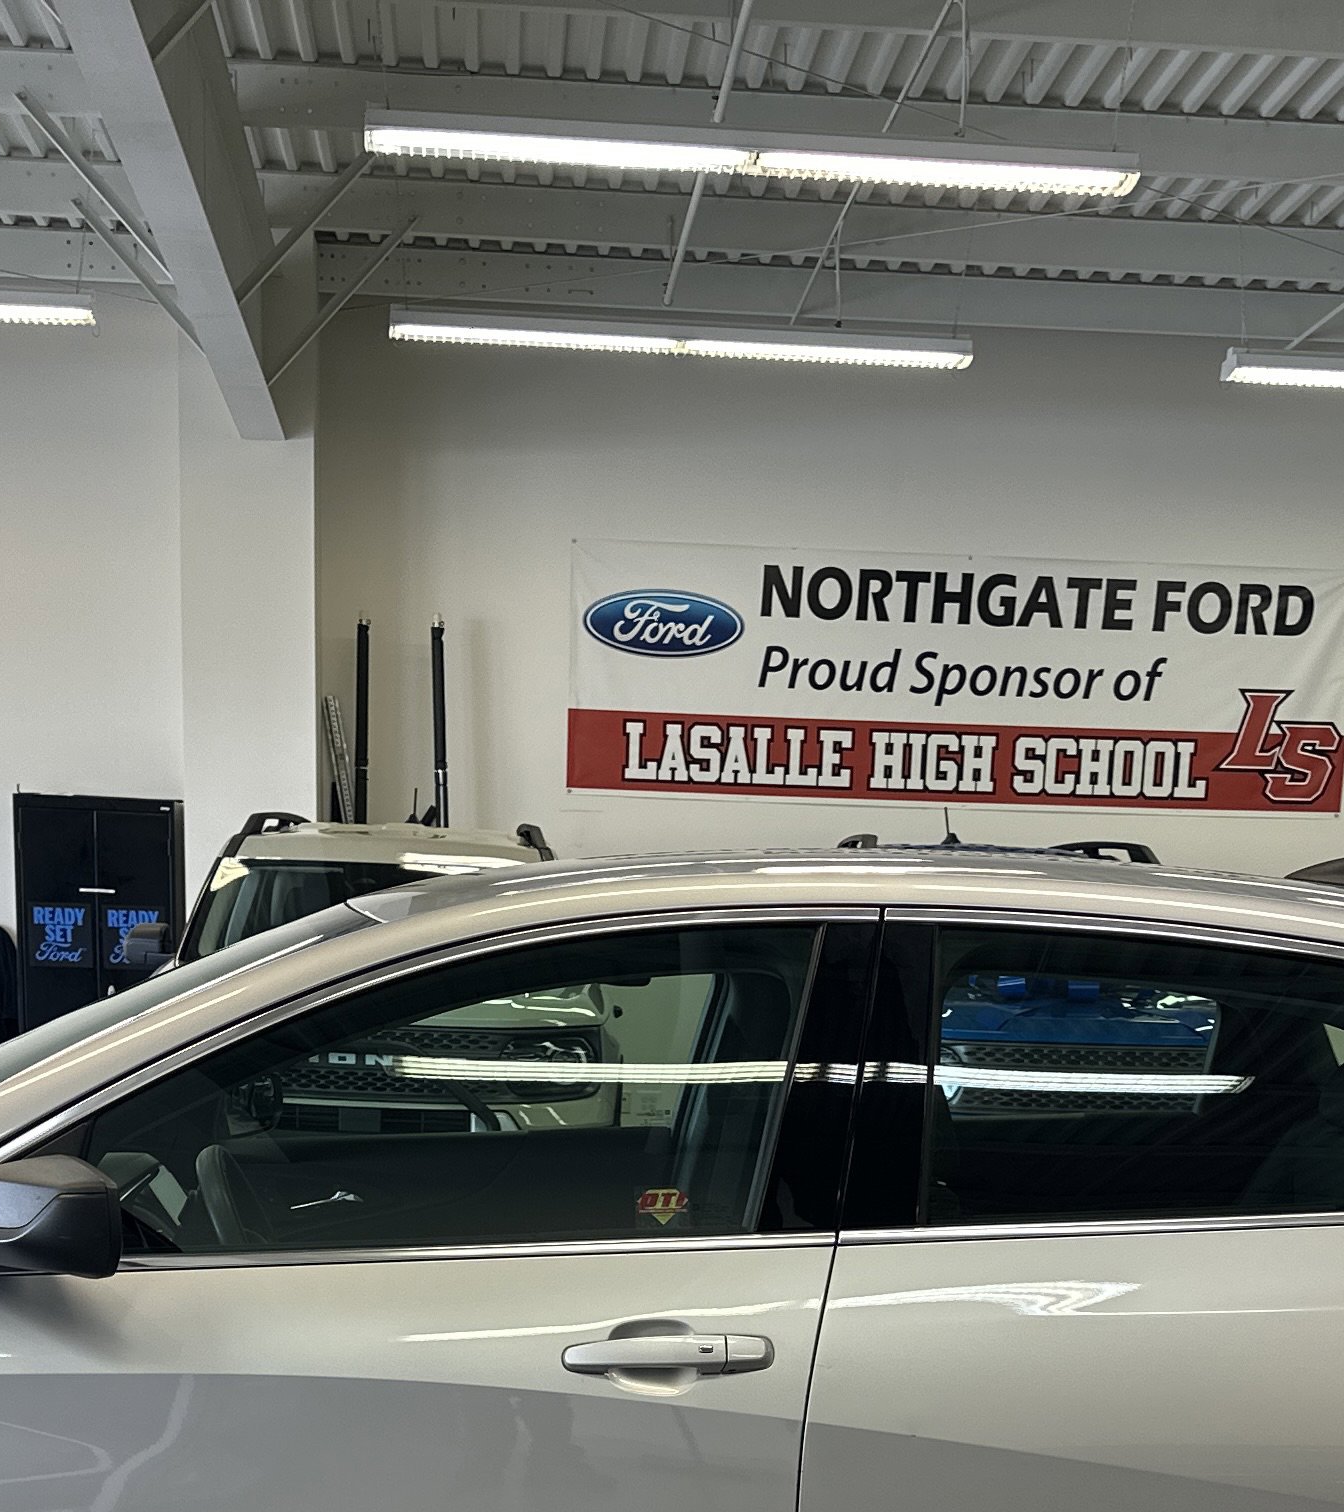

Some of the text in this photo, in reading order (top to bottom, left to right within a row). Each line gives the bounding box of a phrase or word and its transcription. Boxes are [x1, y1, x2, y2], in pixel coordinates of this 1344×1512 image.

[760, 564, 1314, 636] NORTHGATE FORD
[612, 599, 714, 646] Ford
[758, 645, 1168, 706] Proud Sponsor of
[623, 719, 1209, 800] LASALLE HIGH SCHOOL
[32, 906, 85, 926] READY
[107, 909, 159, 928] READY
[44, 925, 74, 942] SET
[35, 942, 83, 962] Ford
